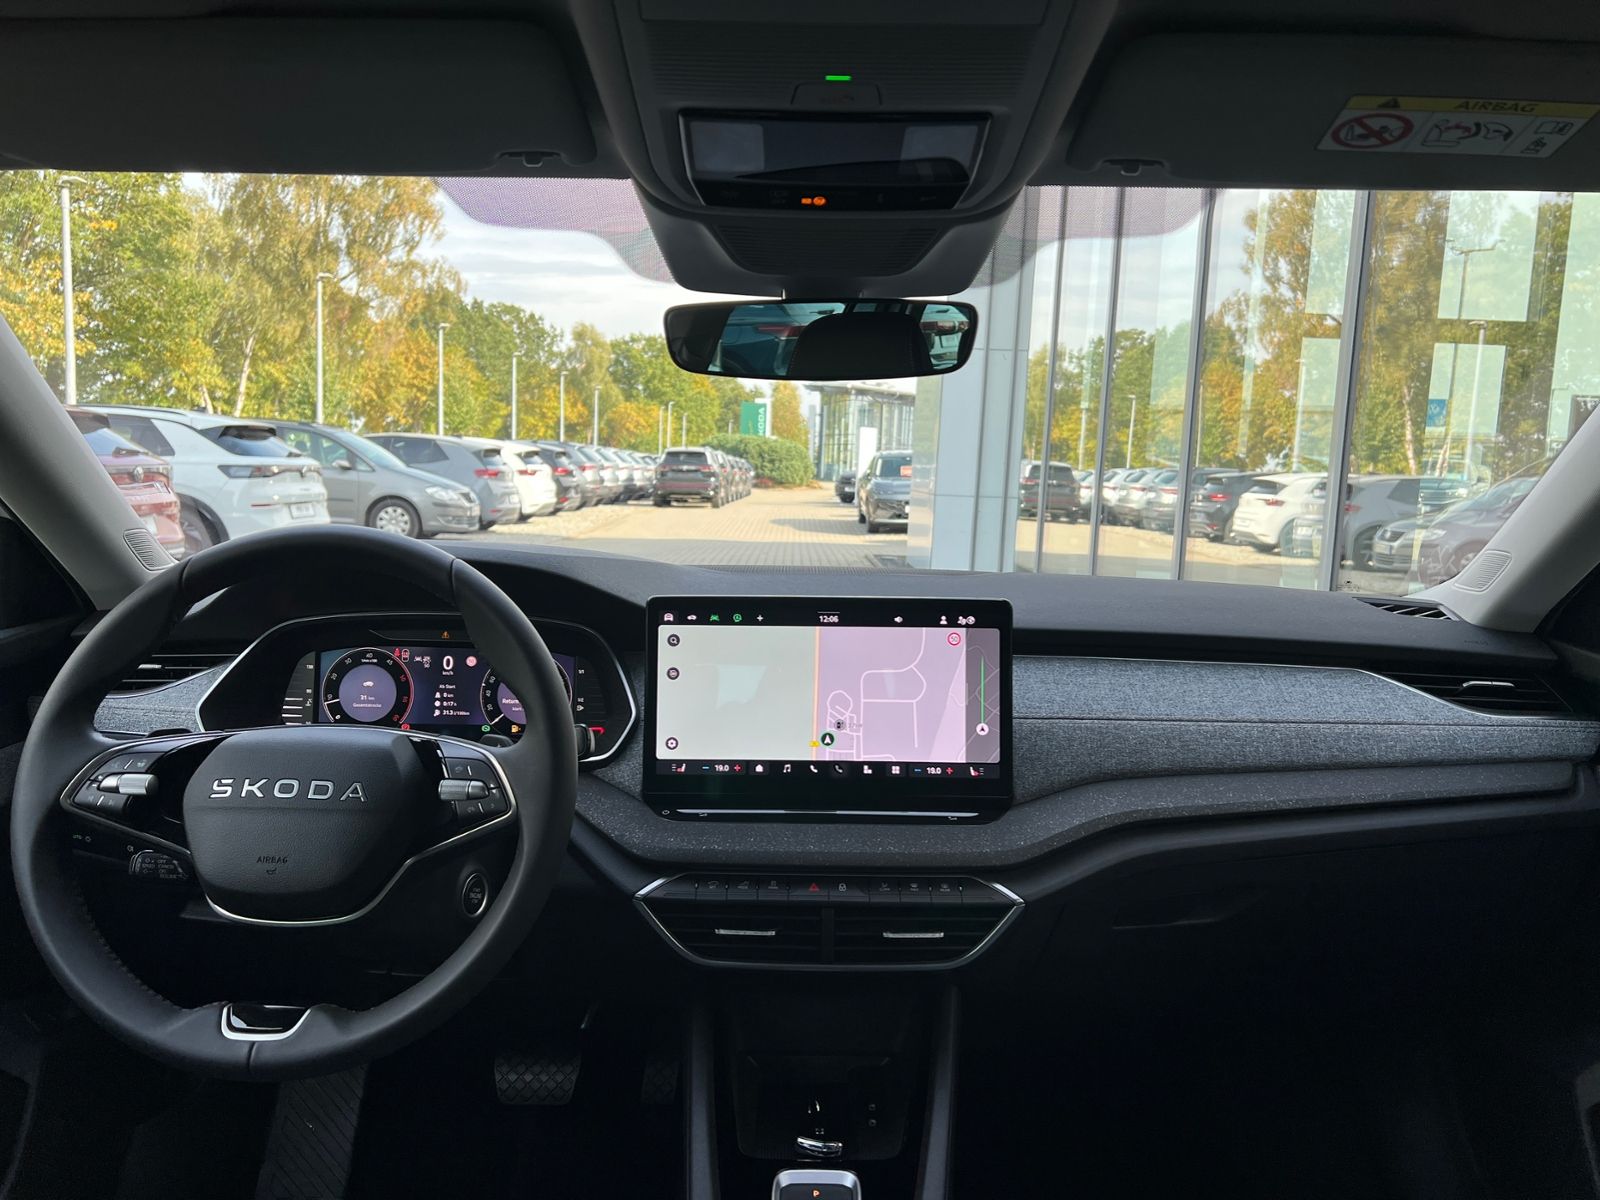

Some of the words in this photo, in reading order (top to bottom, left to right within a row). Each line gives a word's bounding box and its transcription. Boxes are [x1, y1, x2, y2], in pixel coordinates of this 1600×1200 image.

[1453, 100, 1539, 113] AIRBAG
[757, 407, 765, 436] KODA
[819, 615, 839, 623] 12:06
[443, 655, 454, 670] 0
[256, 855, 289, 865] AIRBAG
